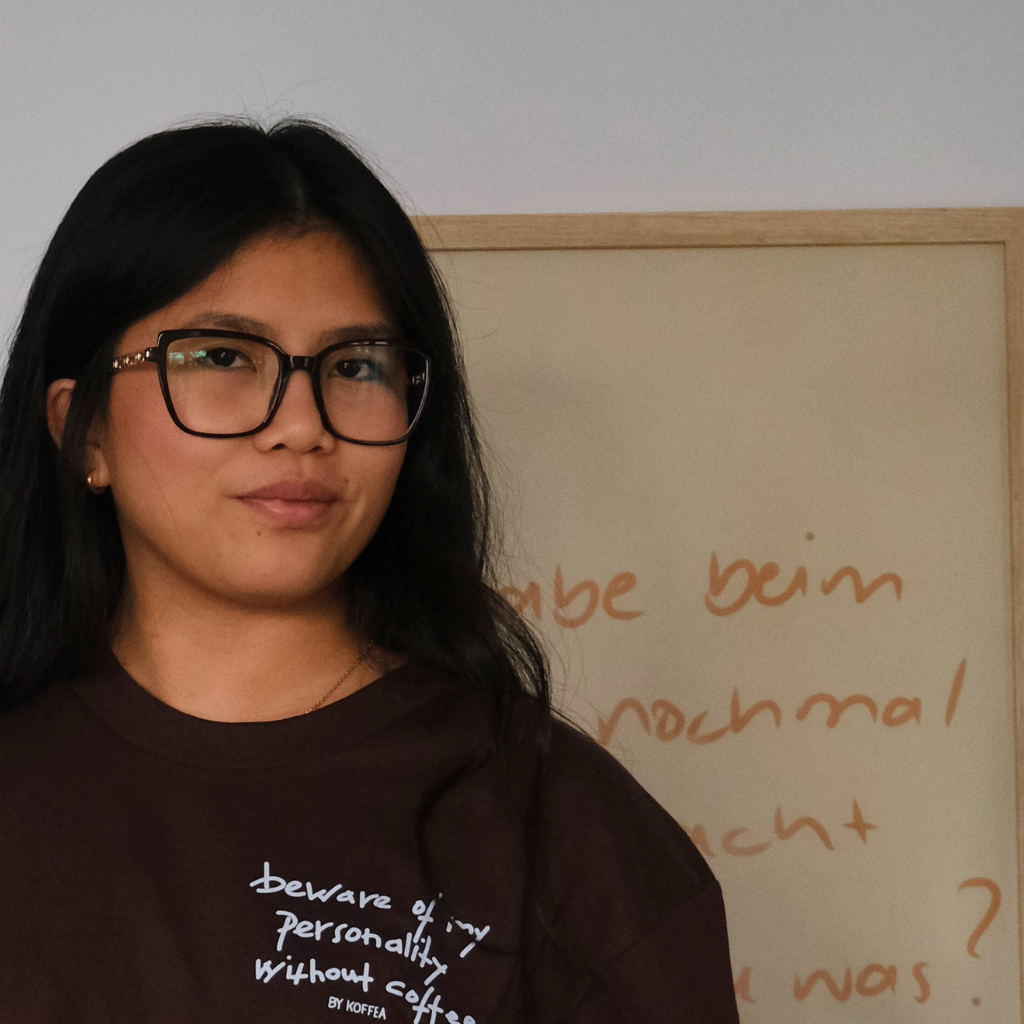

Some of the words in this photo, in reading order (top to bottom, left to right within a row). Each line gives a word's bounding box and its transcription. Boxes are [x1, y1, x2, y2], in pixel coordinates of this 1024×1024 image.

[703, 531, 905, 618] beim
[595, 658, 967, 748] nochmal
[249, 861, 392, 910] beware
[411, 892, 443, 944] of
[254, 954, 375, 993] without
[327, 995, 345, 1010] BY
[345, 999, 387, 1021] KOFFEA
